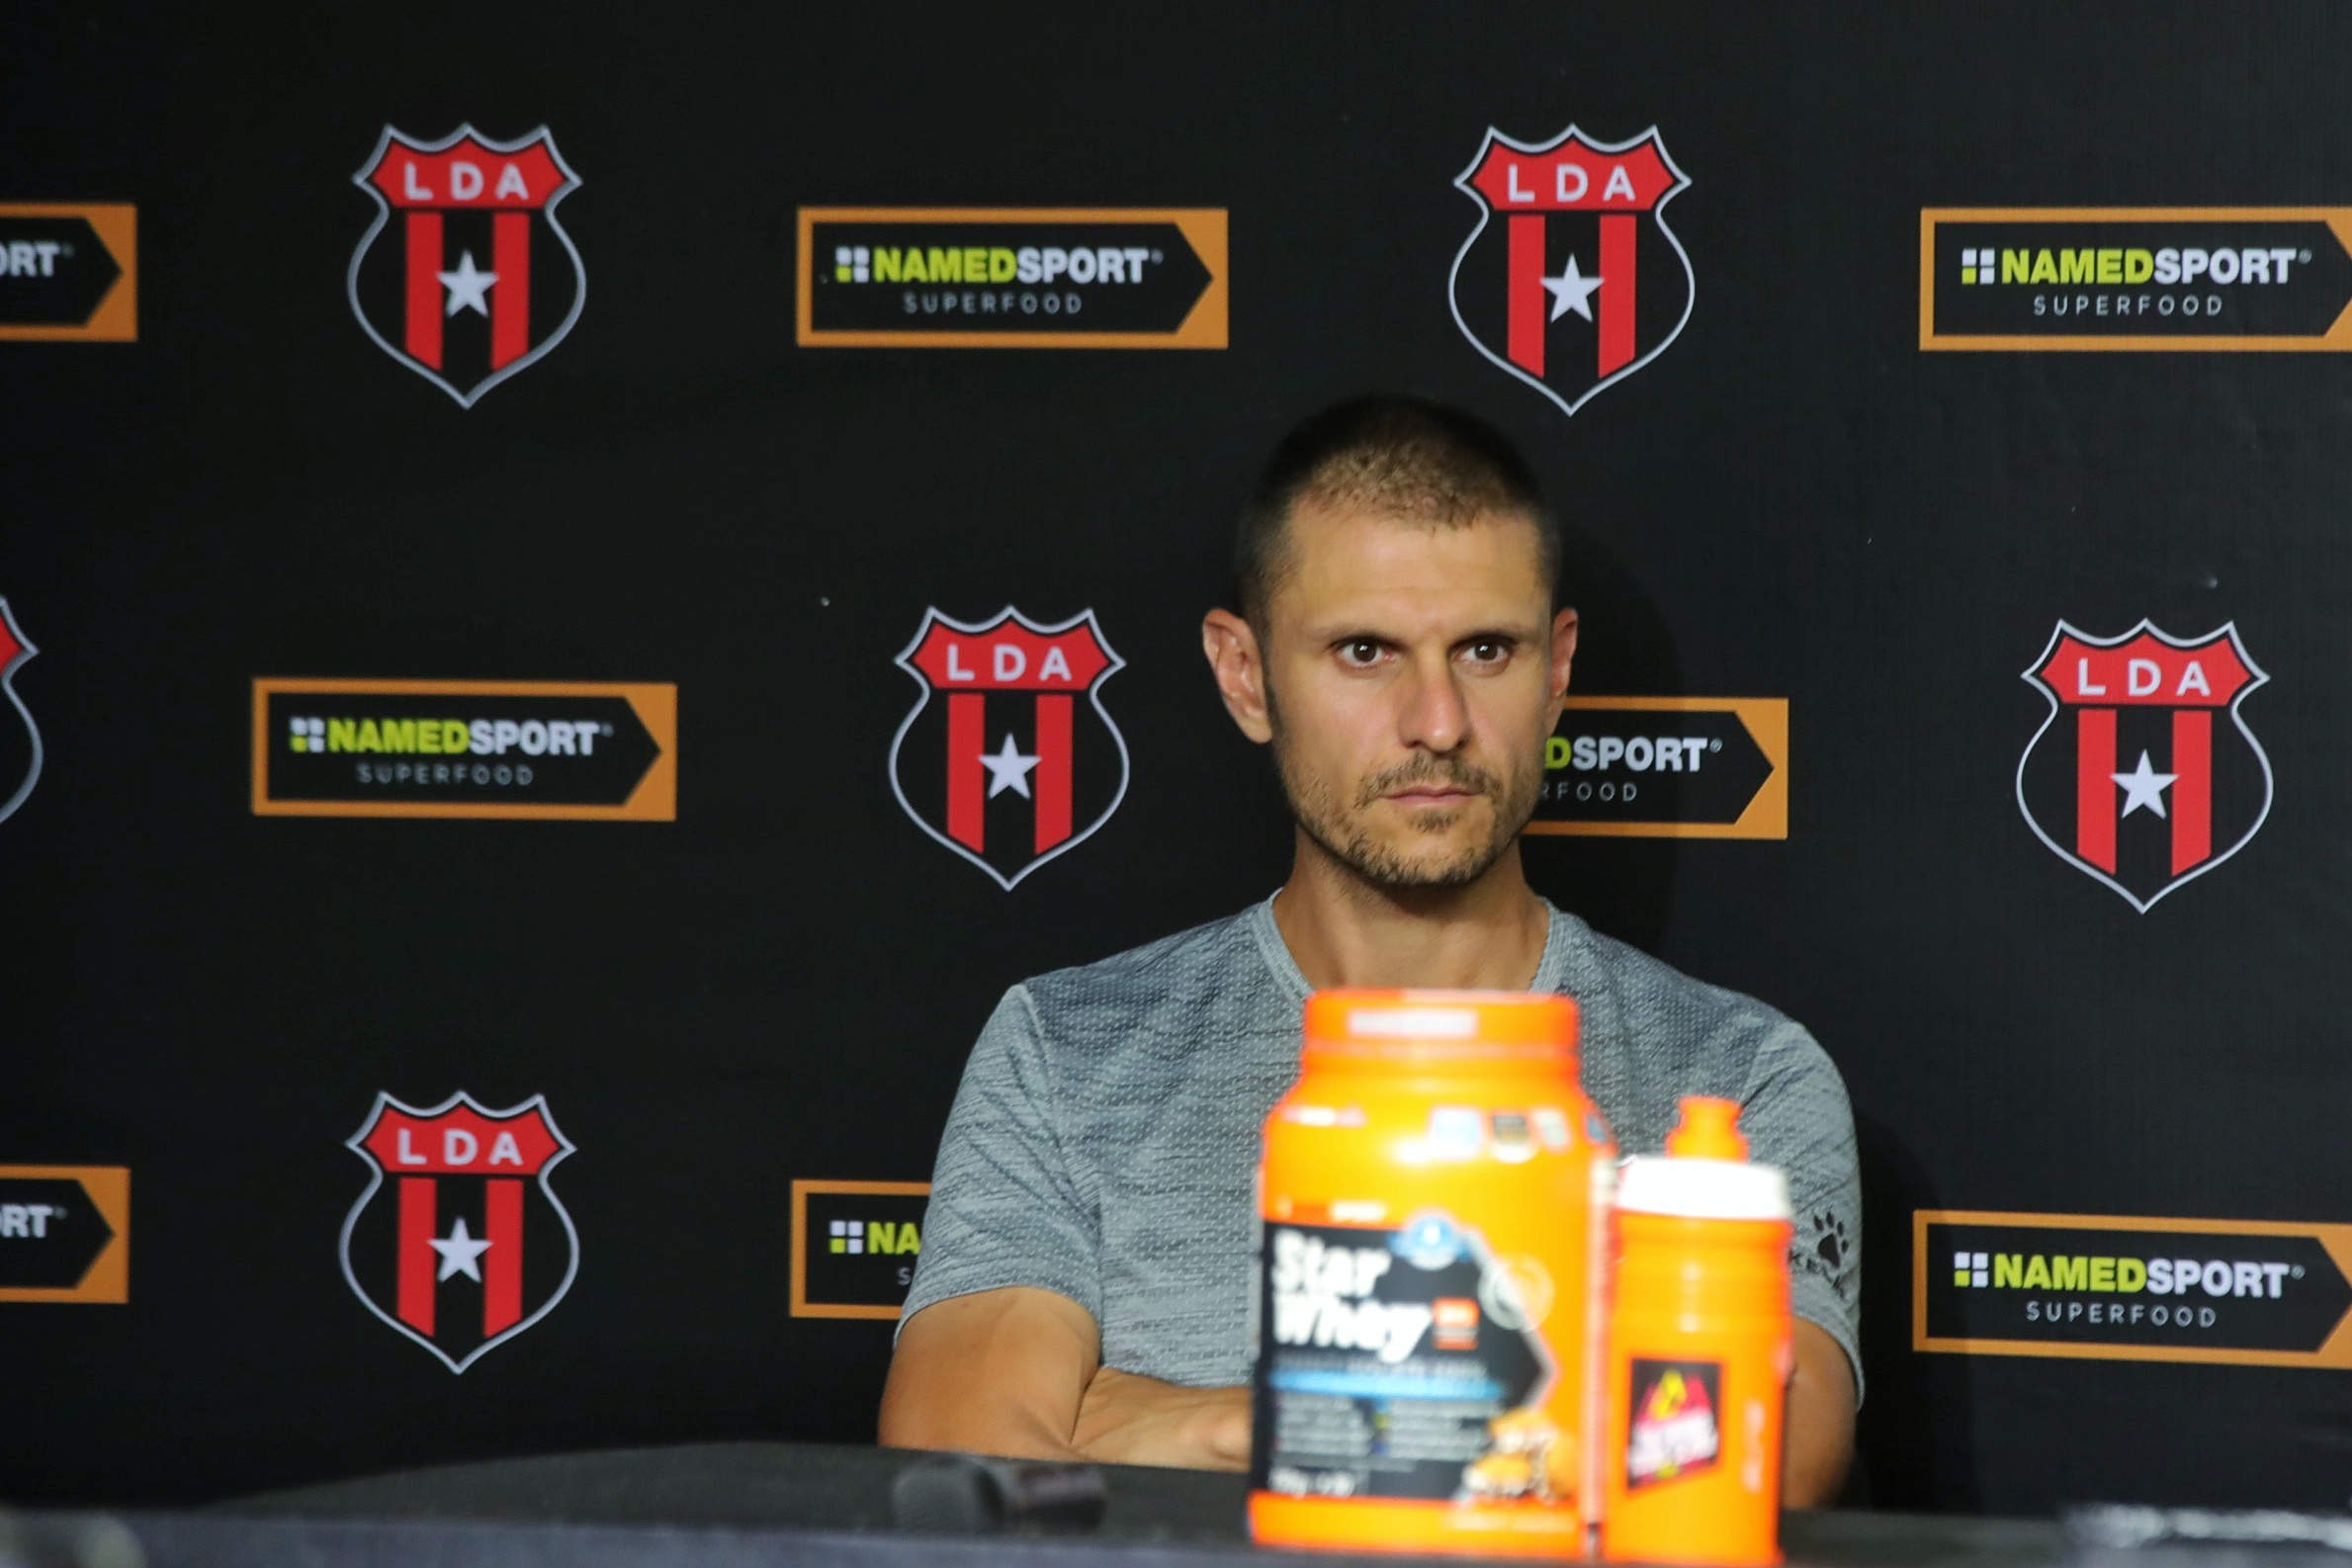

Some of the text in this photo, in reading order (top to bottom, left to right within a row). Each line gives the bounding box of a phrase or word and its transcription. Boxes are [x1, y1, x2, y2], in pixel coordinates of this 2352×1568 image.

[404, 161, 529, 201] LDA
[1508, 163, 1636, 203] LDA
[904, 292, 1083, 315] SUPERFOOD
[2033, 294, 2222, 317] SUPERFOOD
[947, 644, 1073, 683] LDA
[2078, 657, 2212, 698] LDA
[356, 762, 534, 787] SUPERFOOD
[397, 1127, 523, 1167] LDA
[0, 1203, 53, 1239] RT
[2026, 1300, 2217, 1329] SUPERFOOD
